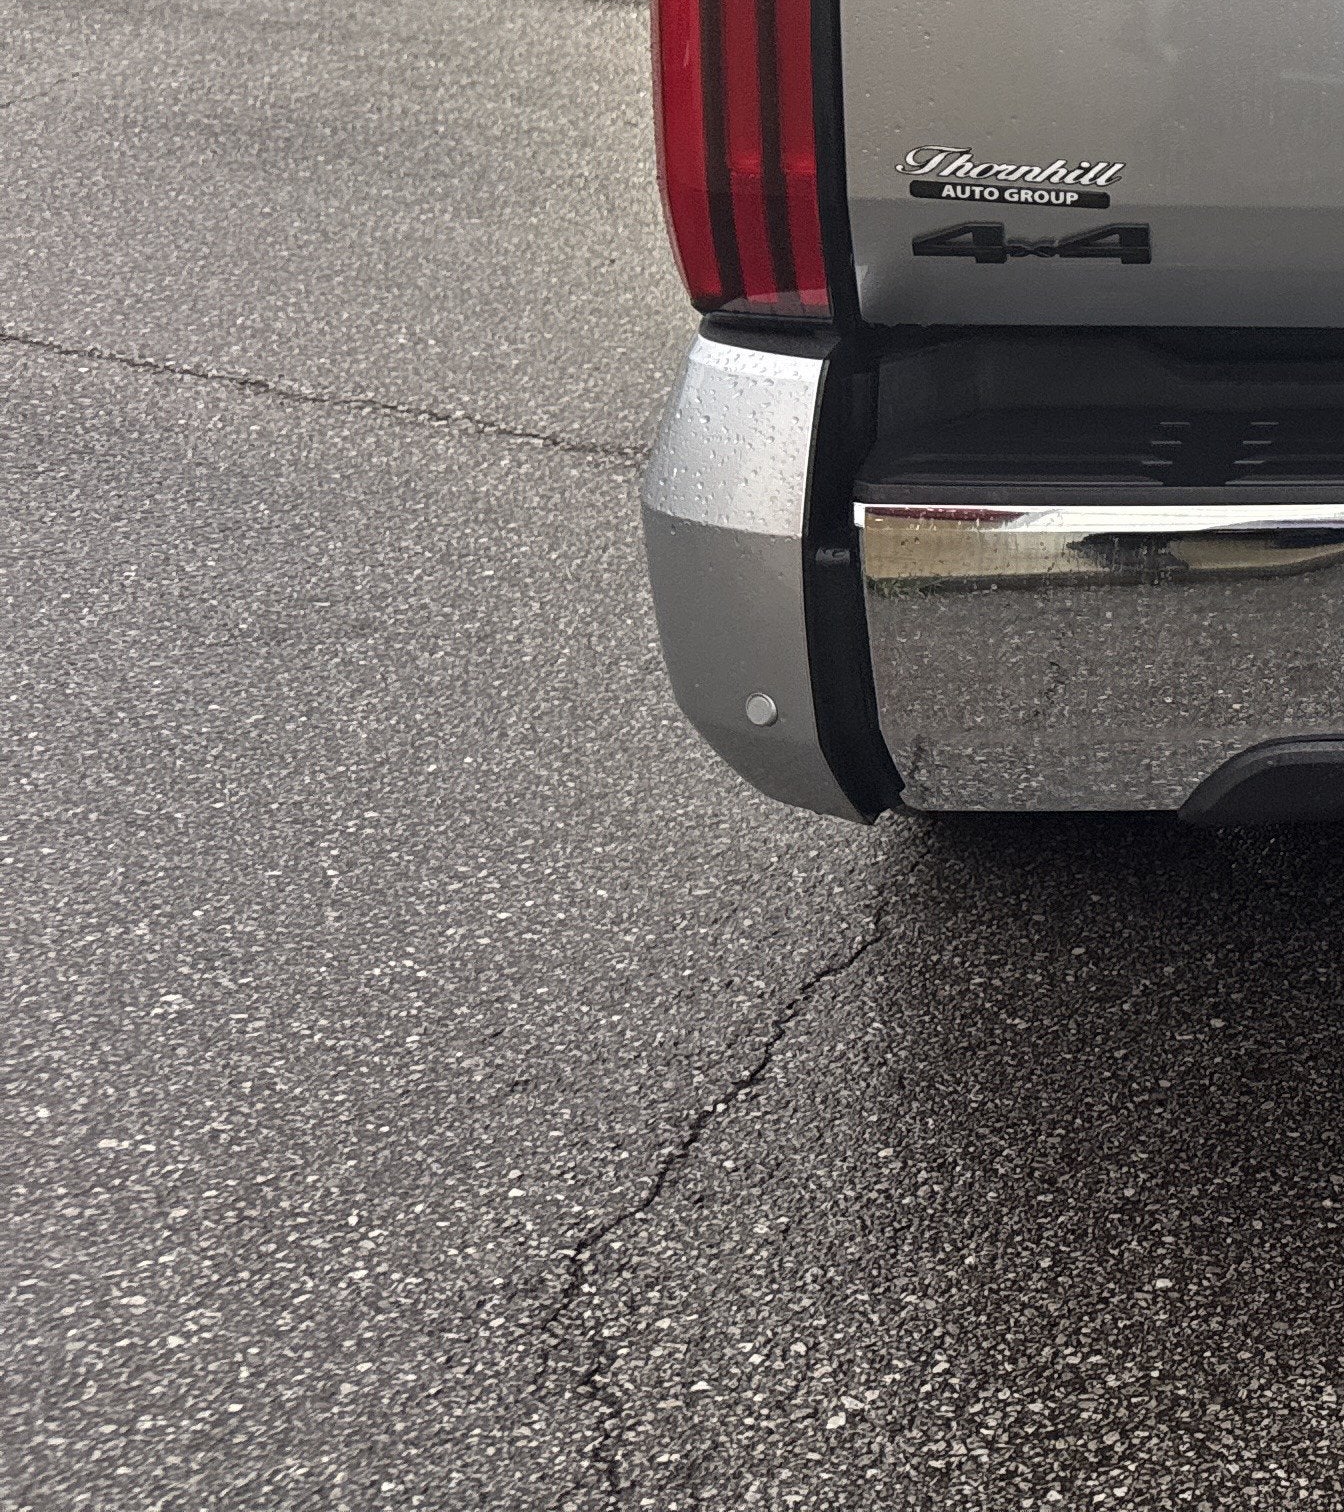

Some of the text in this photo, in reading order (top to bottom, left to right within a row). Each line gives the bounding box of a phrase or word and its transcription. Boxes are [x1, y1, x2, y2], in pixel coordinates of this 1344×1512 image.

[895, 144, 1126, 186] Thornhill
[941, 184, 1079, 206] AUTO GROUP
